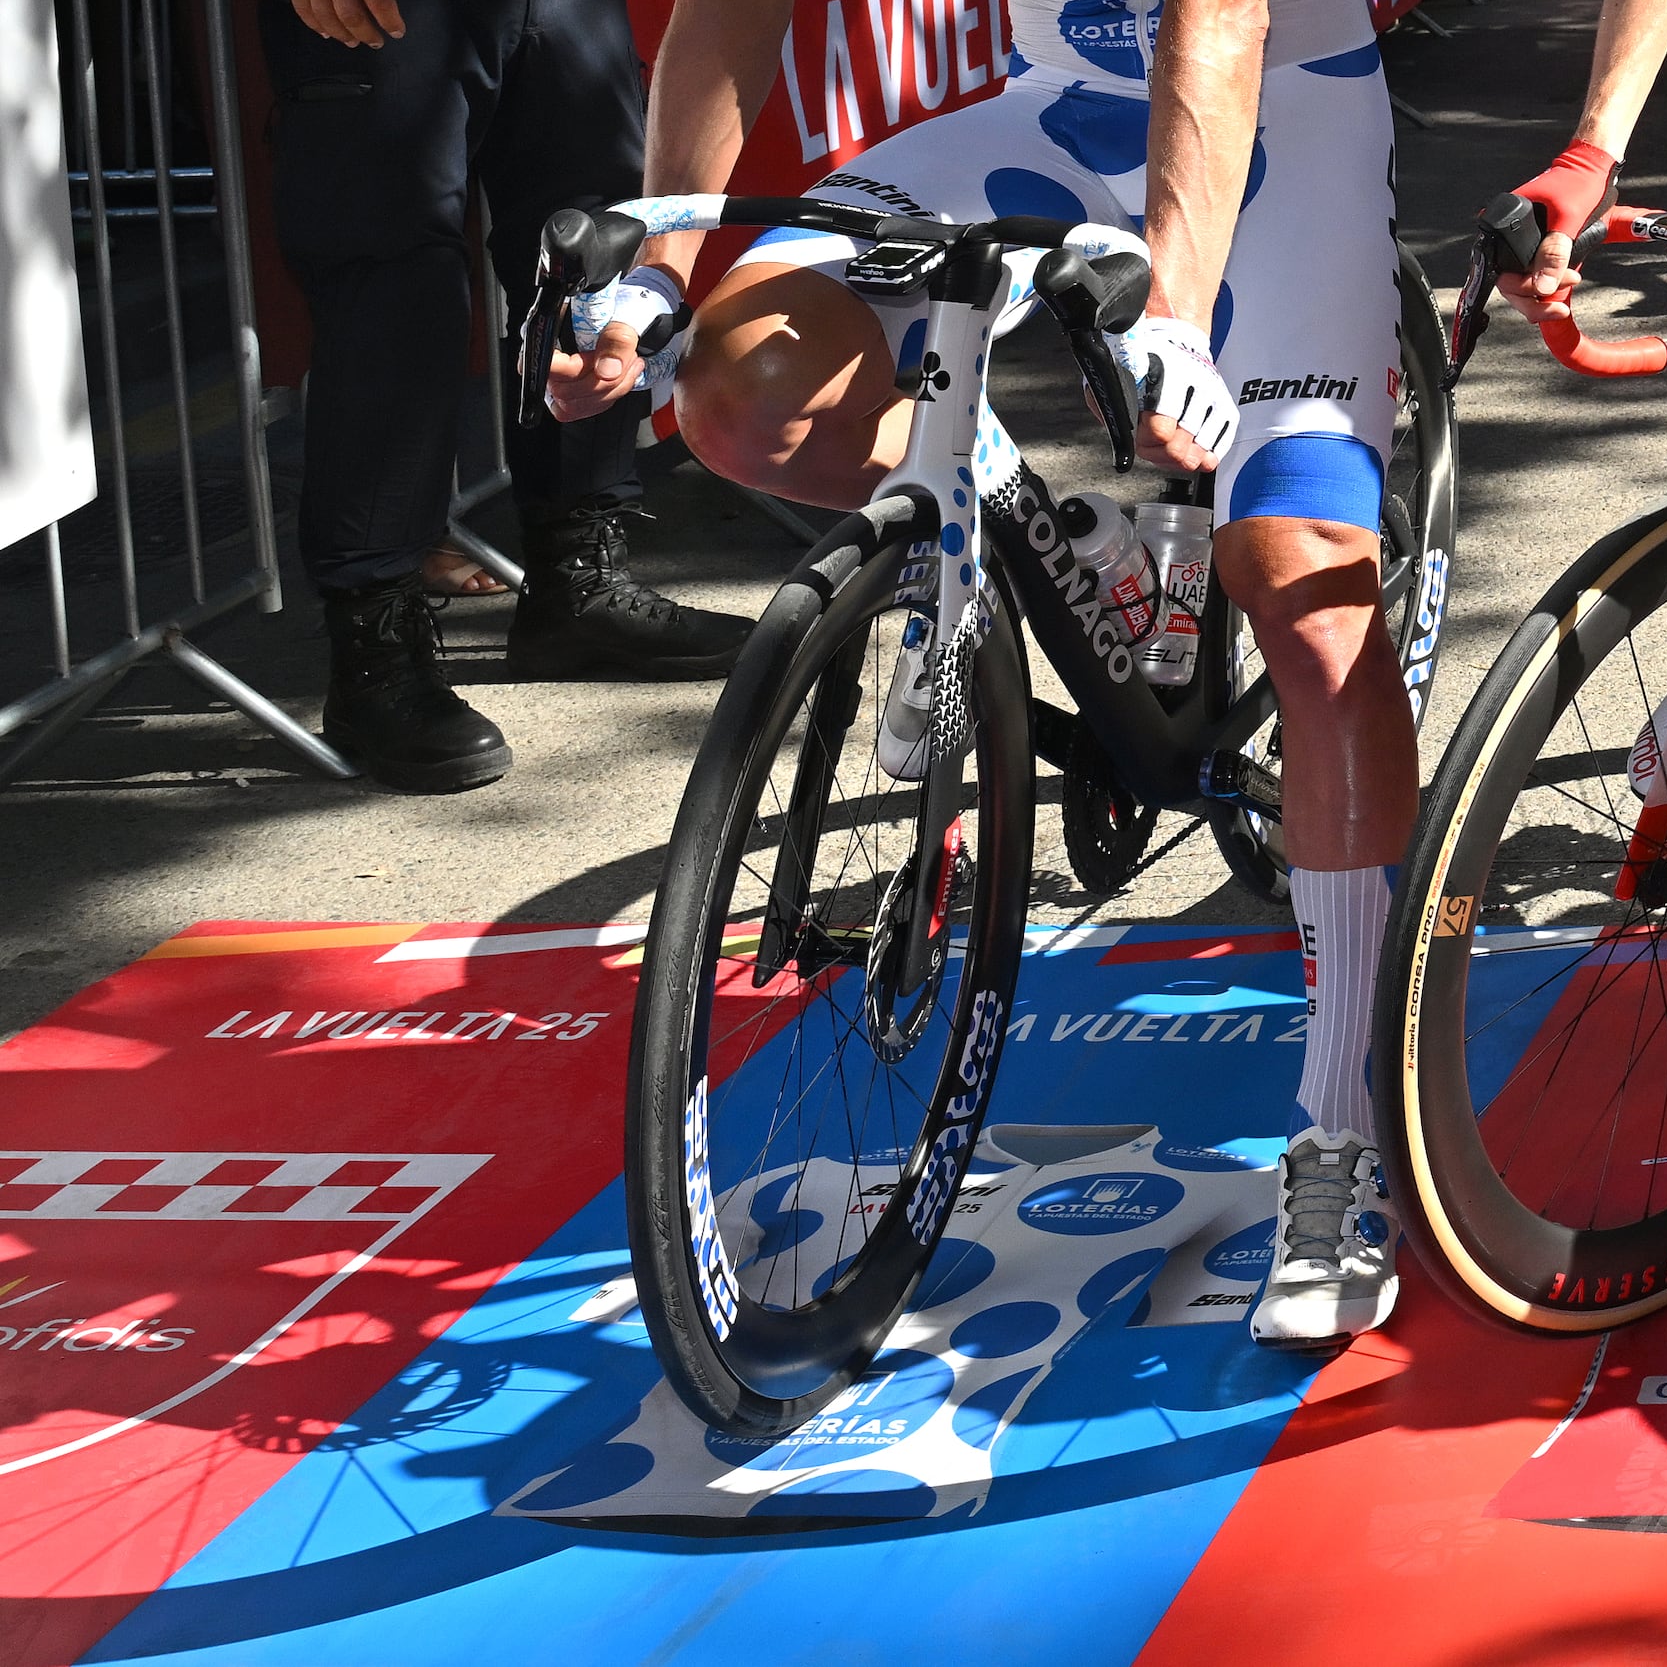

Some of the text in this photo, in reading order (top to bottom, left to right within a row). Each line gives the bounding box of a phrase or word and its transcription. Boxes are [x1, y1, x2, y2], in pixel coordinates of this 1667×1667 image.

[1238, 374, 1358, 406] Santini
[1013, 484, 1134, 684] COLNAGO
[1421, 904, 1436, 944] PRO
[1446, 897, 1468, 937] 57
[1410, 952, 1426, 1018] CORSA
[203, 1010, 609, 1041] LA VUELTA 25
[1043, 1014, 1265, 1043] VUELTA
[1407, 1022, 1417, 1061] vittoria
[1030, 1200, 1159, 1216] LOTERÍAS
[0, 1318, 196, 1352] ofidis
[795, 1414, 909, 1436] ERÍAS
[802, 1436, 828, 1446] DEL
[835, 1436, 900, 1445] ESTADO
